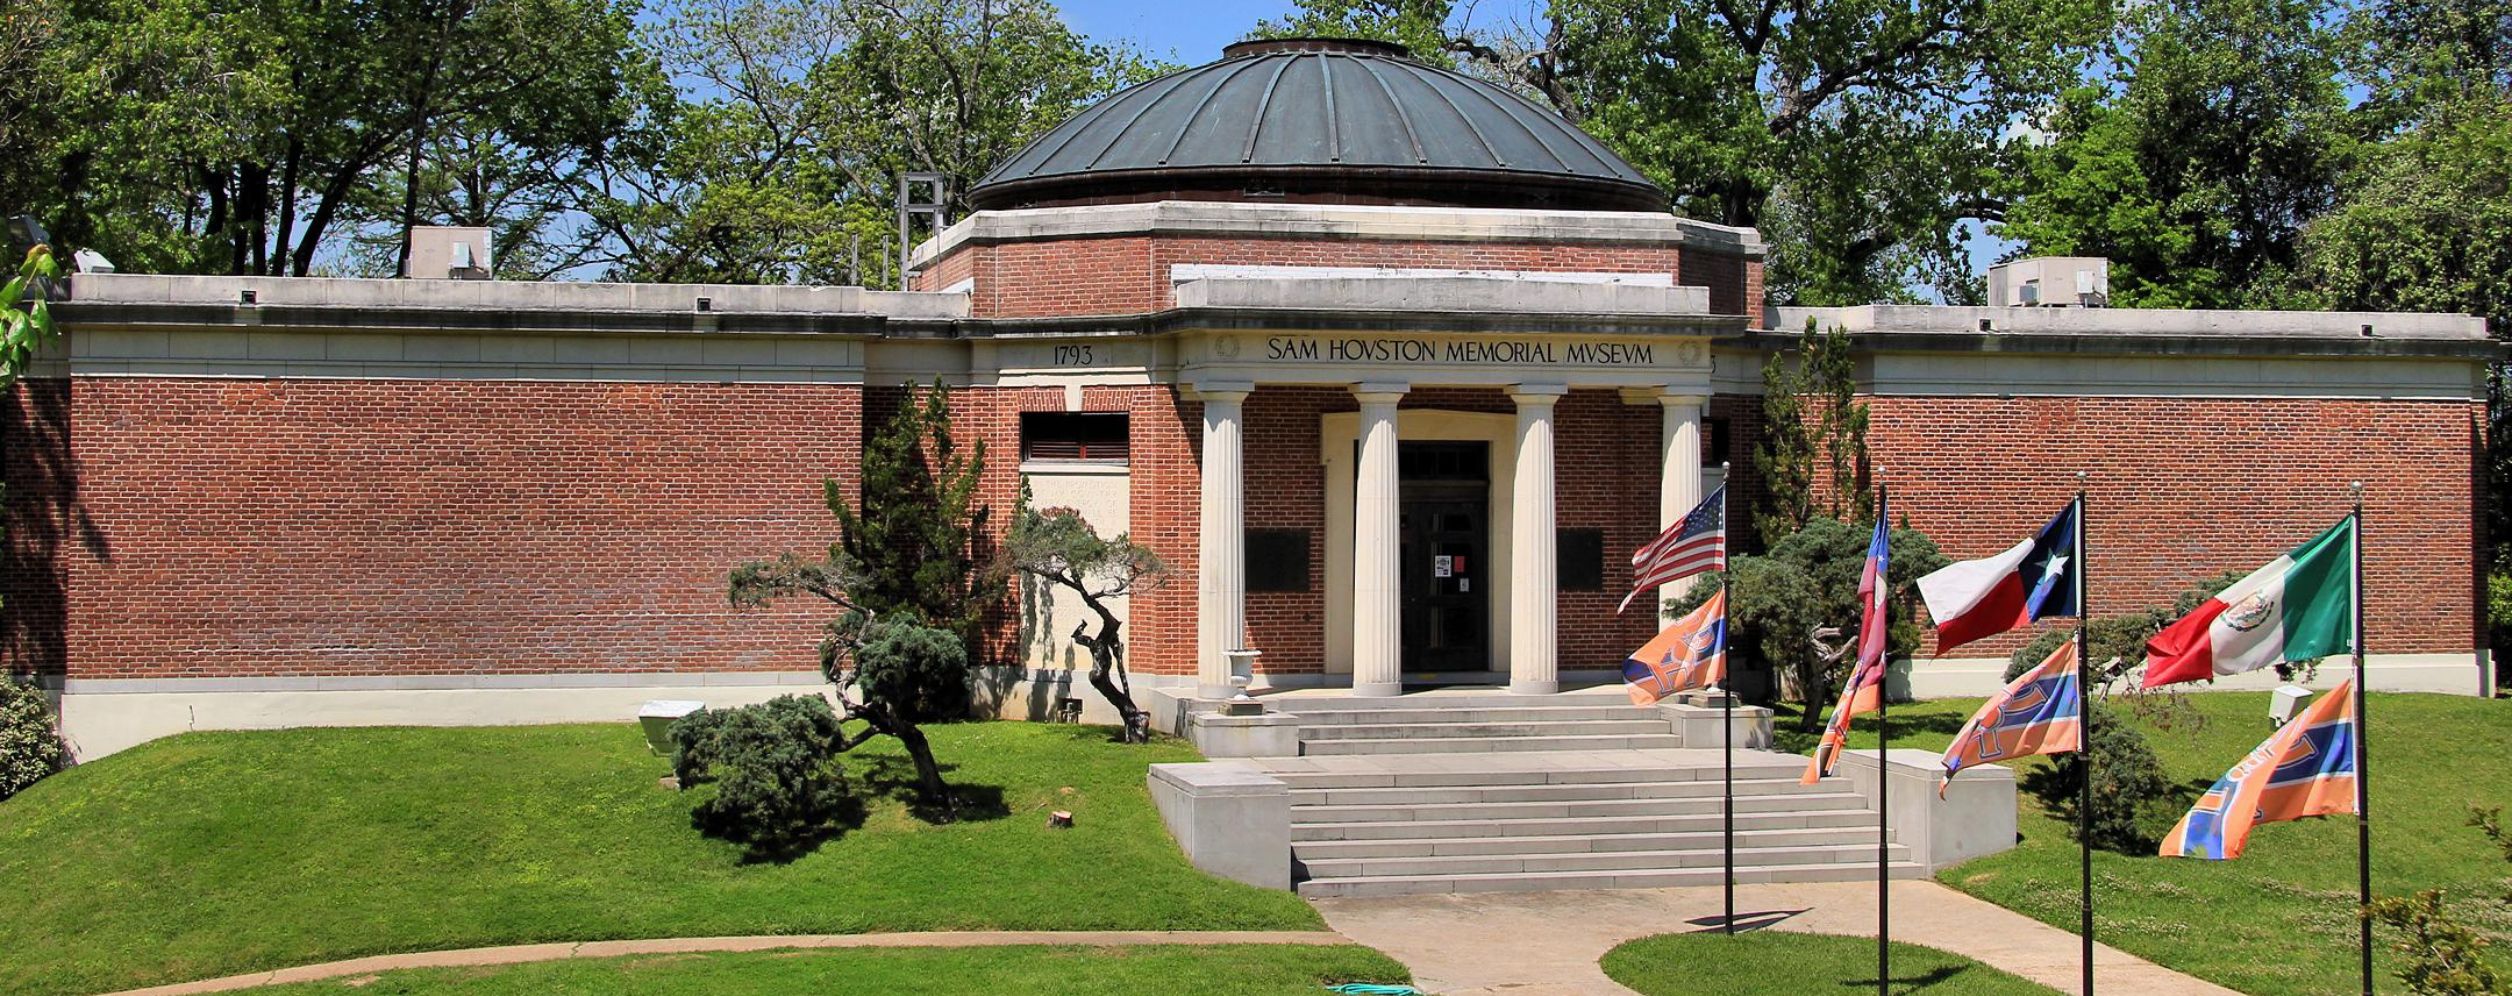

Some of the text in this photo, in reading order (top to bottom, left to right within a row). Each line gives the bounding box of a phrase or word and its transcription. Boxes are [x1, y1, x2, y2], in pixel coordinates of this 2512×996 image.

[1054, 345, 1093, 366] 1793
[1268, 338, 1654, 364] SAM HOVSTON MEMORIAL MVSEVM
